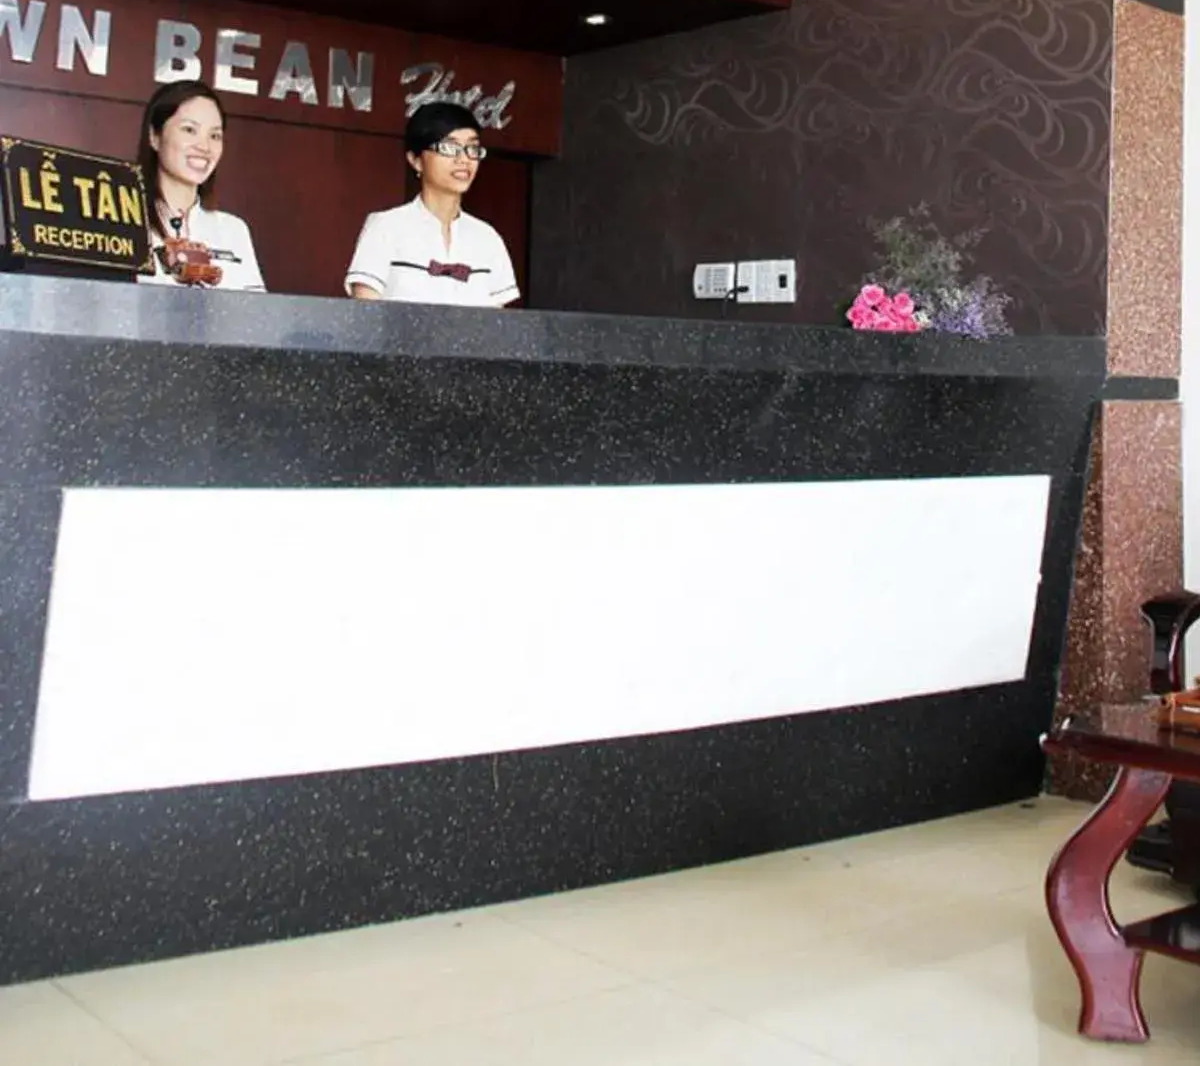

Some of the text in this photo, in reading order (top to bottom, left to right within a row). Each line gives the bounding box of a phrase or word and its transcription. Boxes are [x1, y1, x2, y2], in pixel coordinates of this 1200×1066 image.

[154, 19, 374, 112] BEAN
[19, 151, 143, 226] LỄ TÂN
[33, 223, 134, 256] RECEPTION
